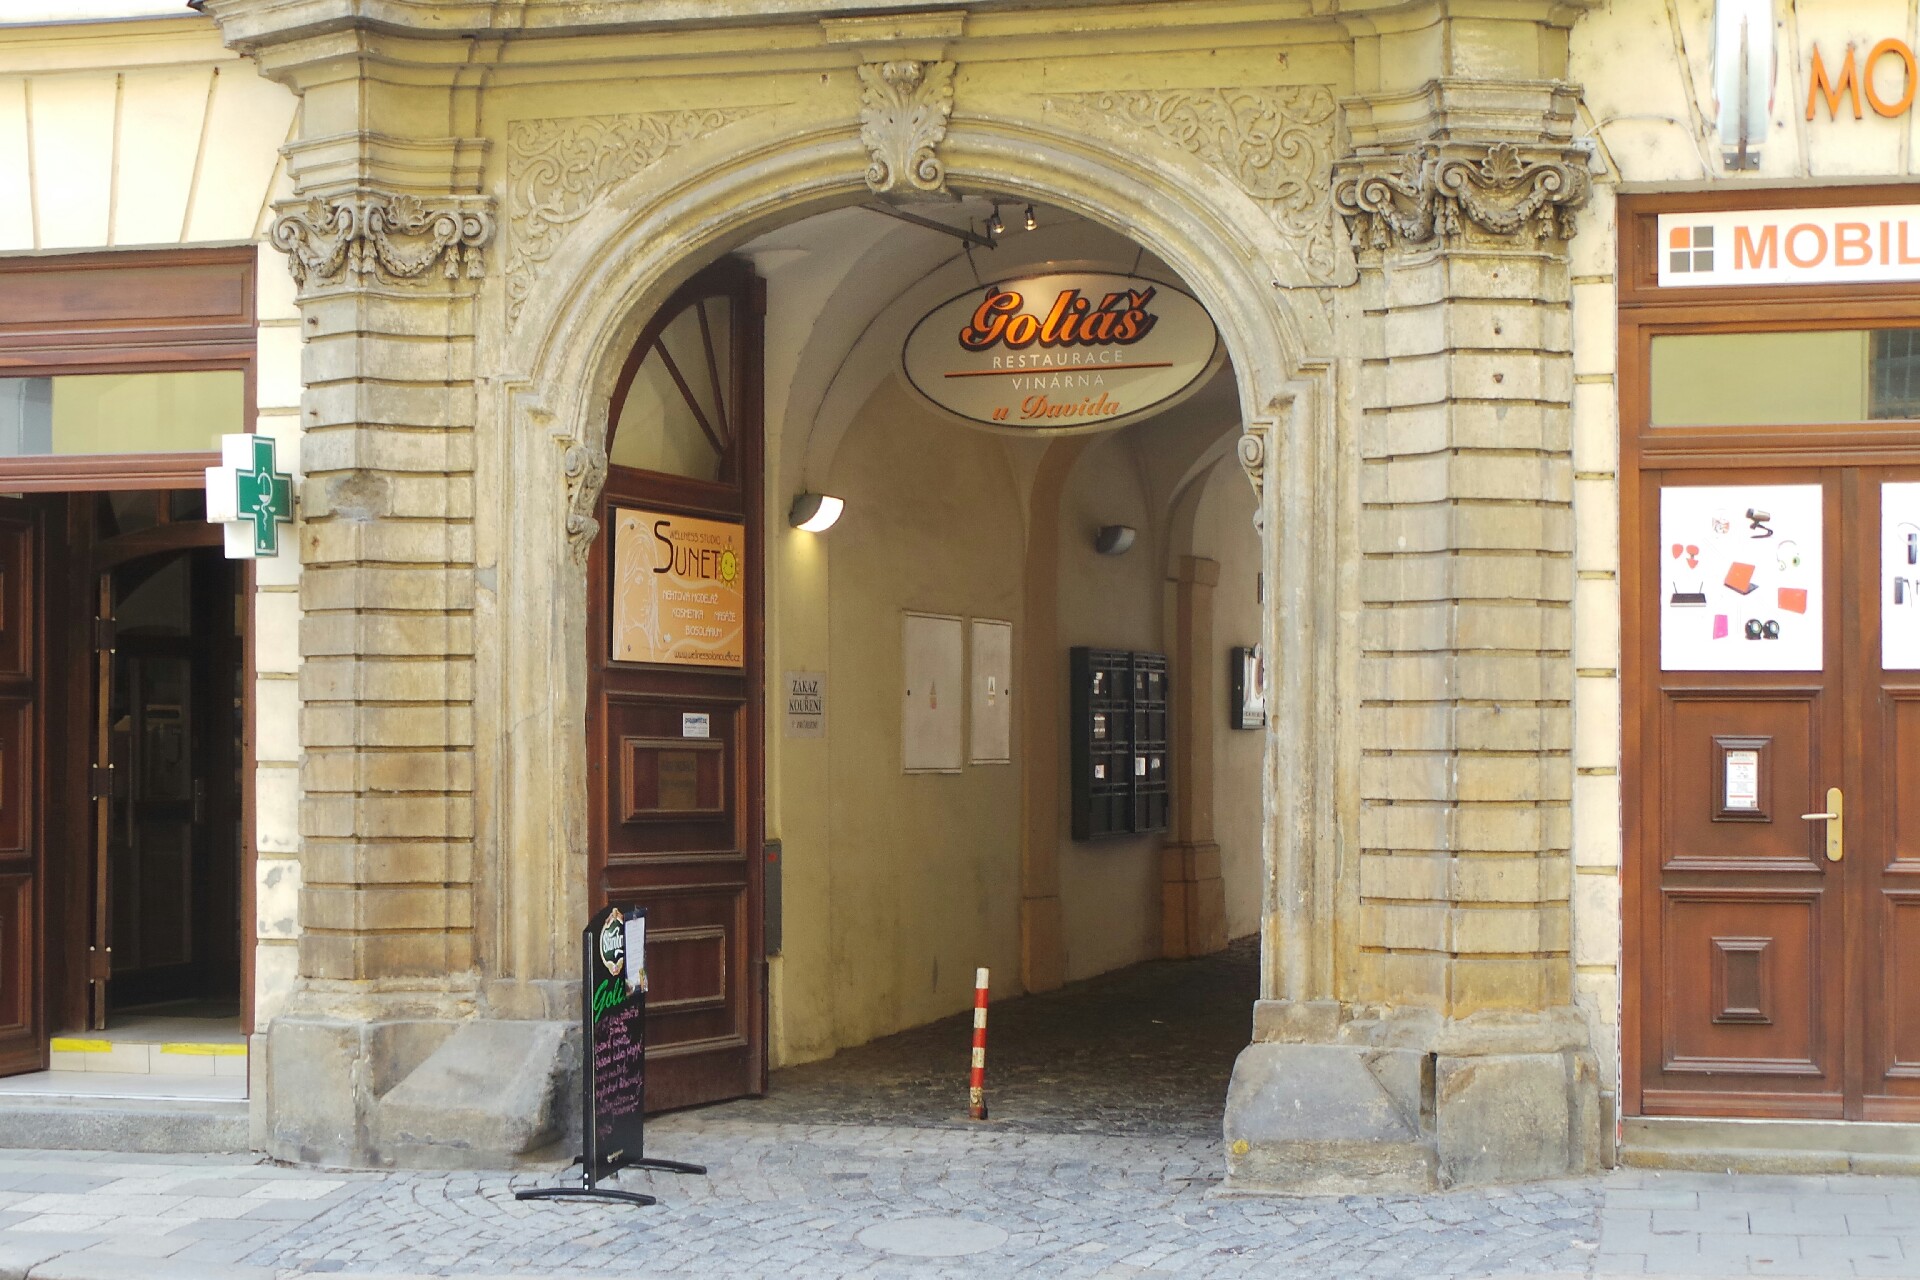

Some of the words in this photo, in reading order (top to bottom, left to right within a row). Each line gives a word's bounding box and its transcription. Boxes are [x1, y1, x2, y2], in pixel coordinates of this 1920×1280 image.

[959, 286, 1158, 352] Goliáš
[993, 350, 1123, 369] RESTAURACE
[1012, 372, 1104, 390] VINÁRNA
[992, 405, 1009, 420] u
[1020, 392, 1120, 420] Davida
[669, 530, 699, 543] WELLNESS
[700, 533, 721, 545] STUDIO
